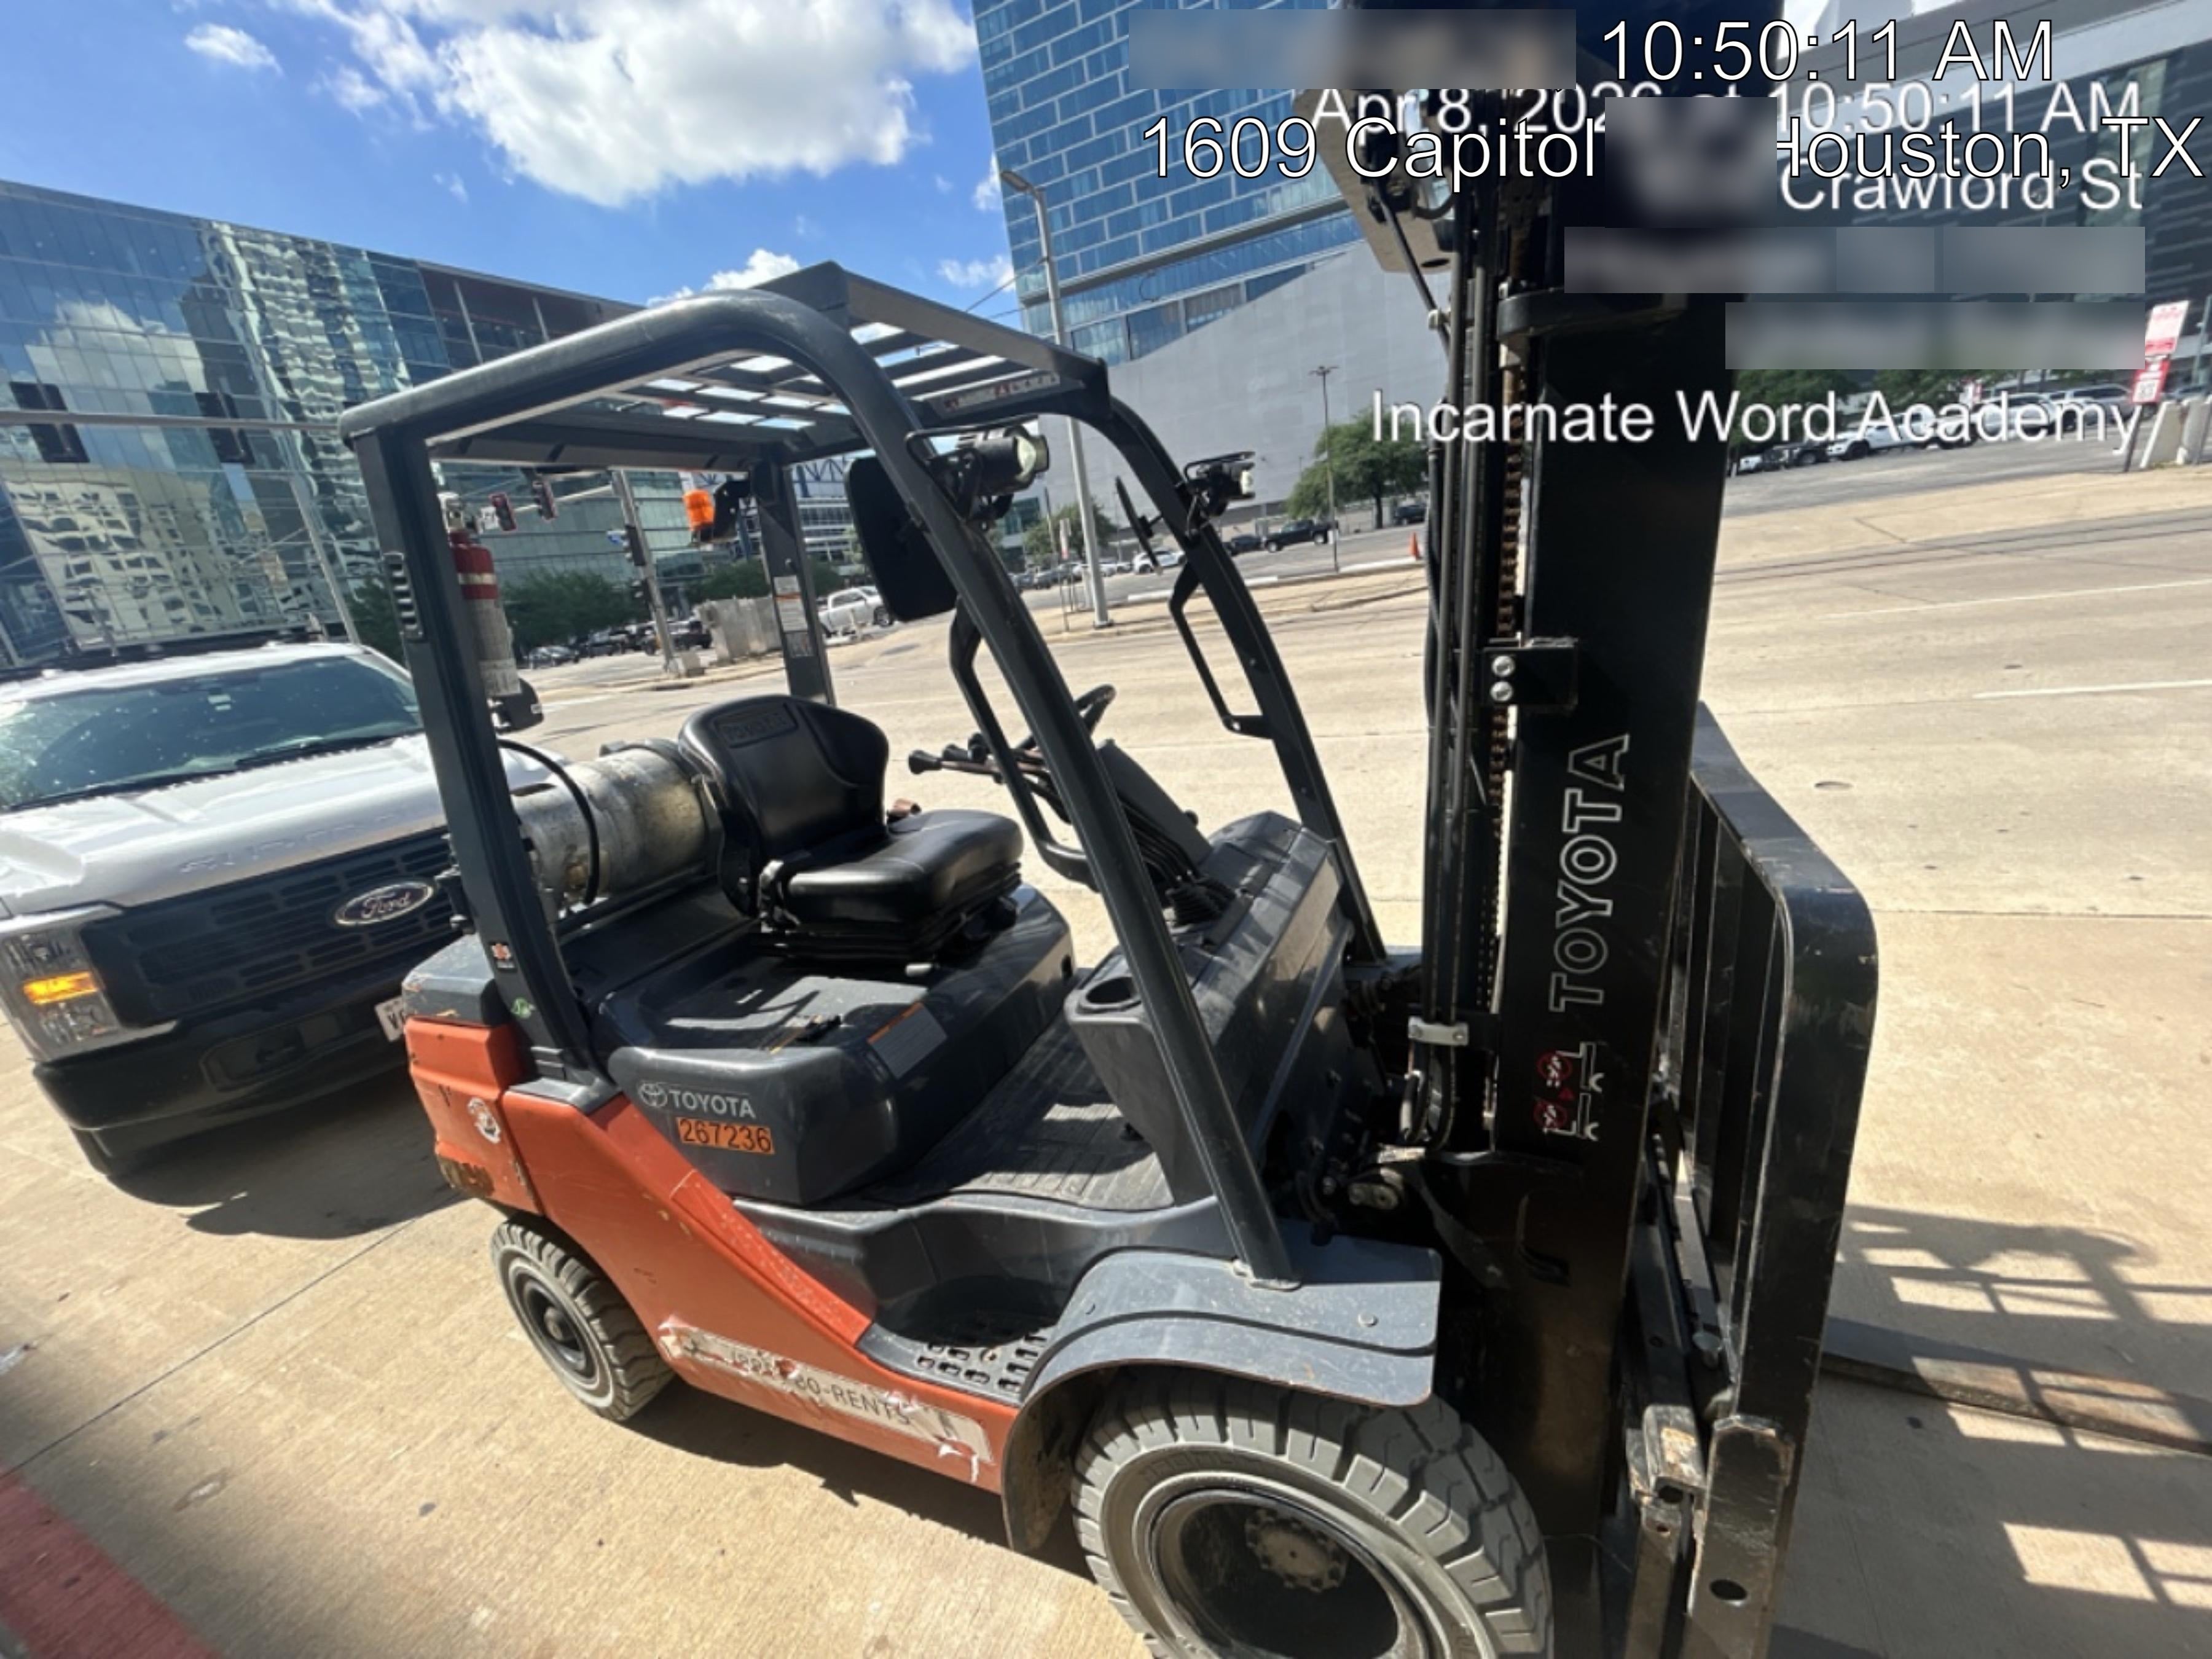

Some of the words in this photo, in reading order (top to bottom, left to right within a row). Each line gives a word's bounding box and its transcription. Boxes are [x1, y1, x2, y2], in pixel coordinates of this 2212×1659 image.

[1550, 732, 1630, 1013] TOYOTA
[361, 891, 412, 919] Ford
[669, 1090, 756, 1119] TOYOTA
[680, 1118, 772, 1153] 267236
